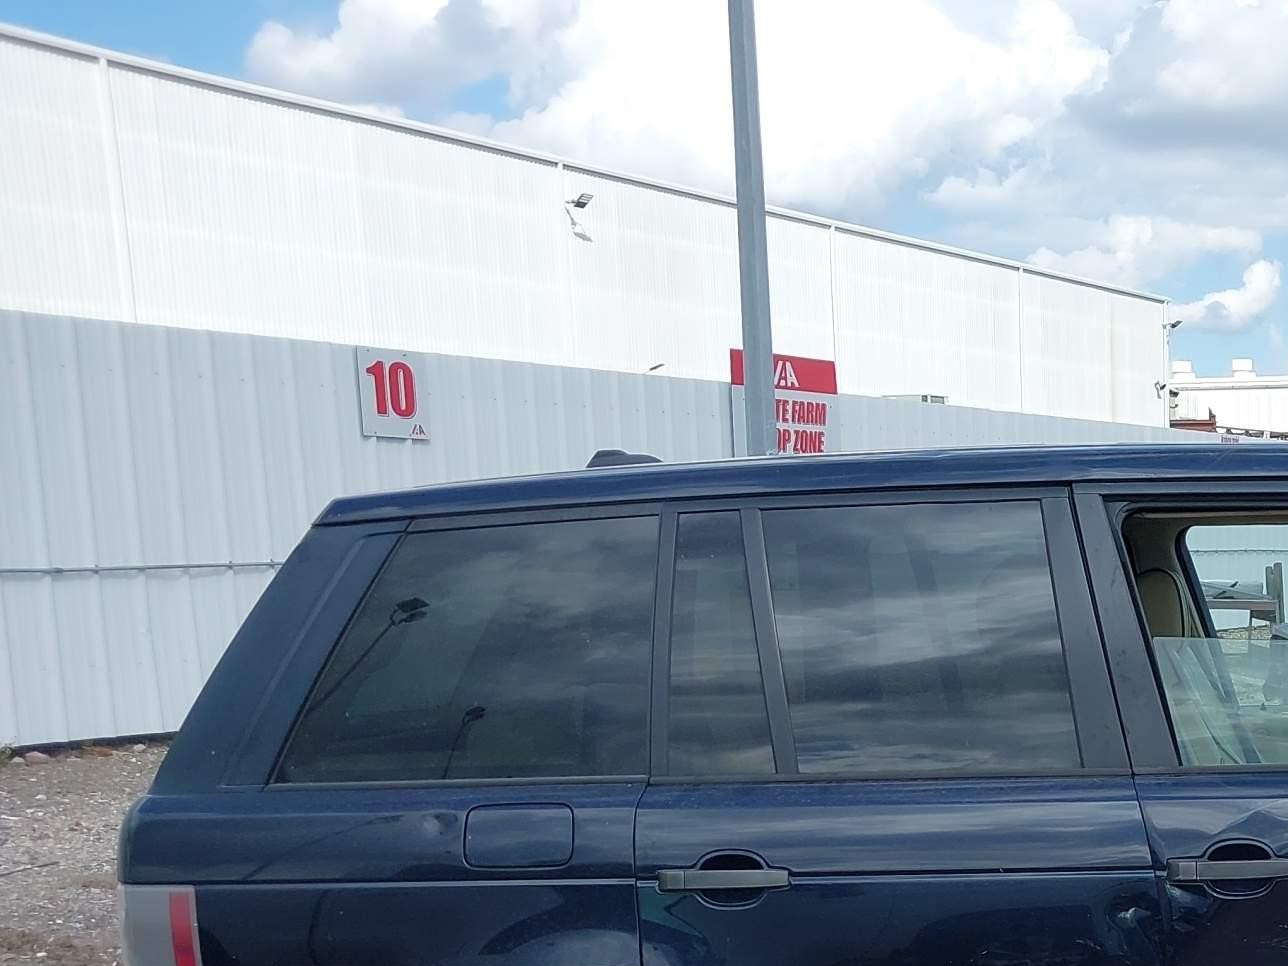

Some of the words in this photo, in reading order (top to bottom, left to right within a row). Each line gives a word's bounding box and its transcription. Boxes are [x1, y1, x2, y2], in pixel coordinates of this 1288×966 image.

[365, 360, 417, 419] 10
[791, 400, 827, 427] FARM
[793, 429, 825, 455] ZONE
